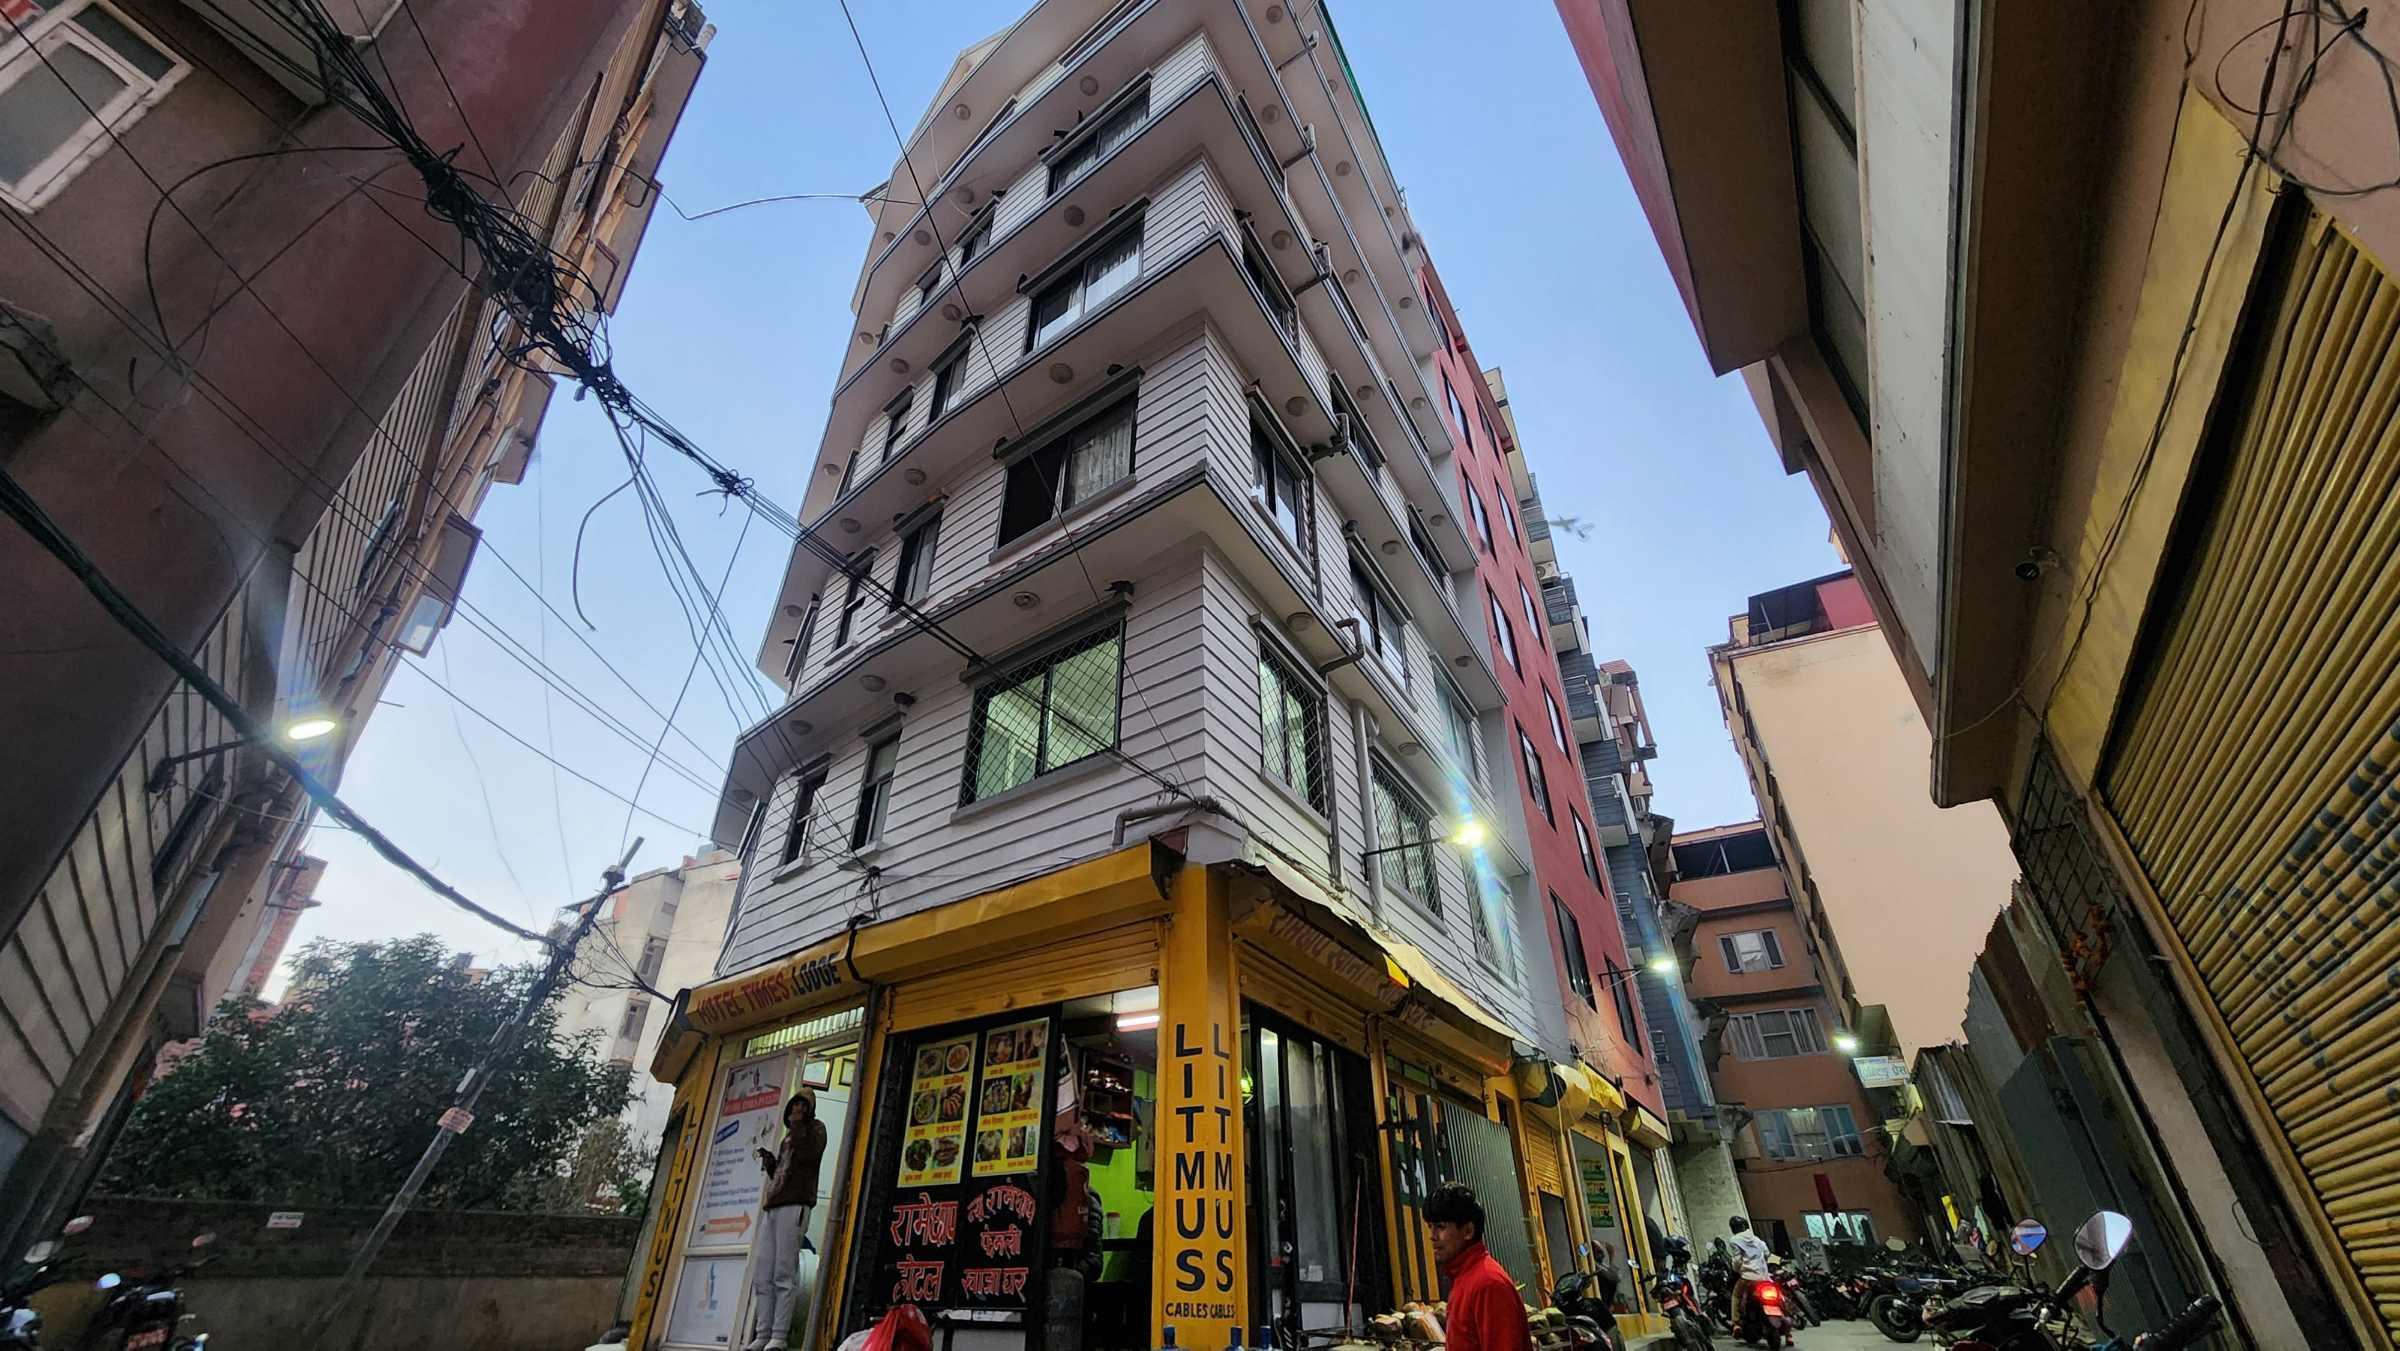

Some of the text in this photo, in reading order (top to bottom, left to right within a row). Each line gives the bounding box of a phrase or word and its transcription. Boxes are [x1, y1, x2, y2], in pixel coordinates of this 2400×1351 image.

[697, 988, 745, 1025] HOTEL
[741, 971, 790, 1009] TIMES
[1175, 1023, 1206, 1292] LITMUS
[1213, 1022, 1234, 1292] LITMUS
[892, 1254, 945, 1302] होटल
[1165, 1302, 1236, 1319] CABLES CABLES
